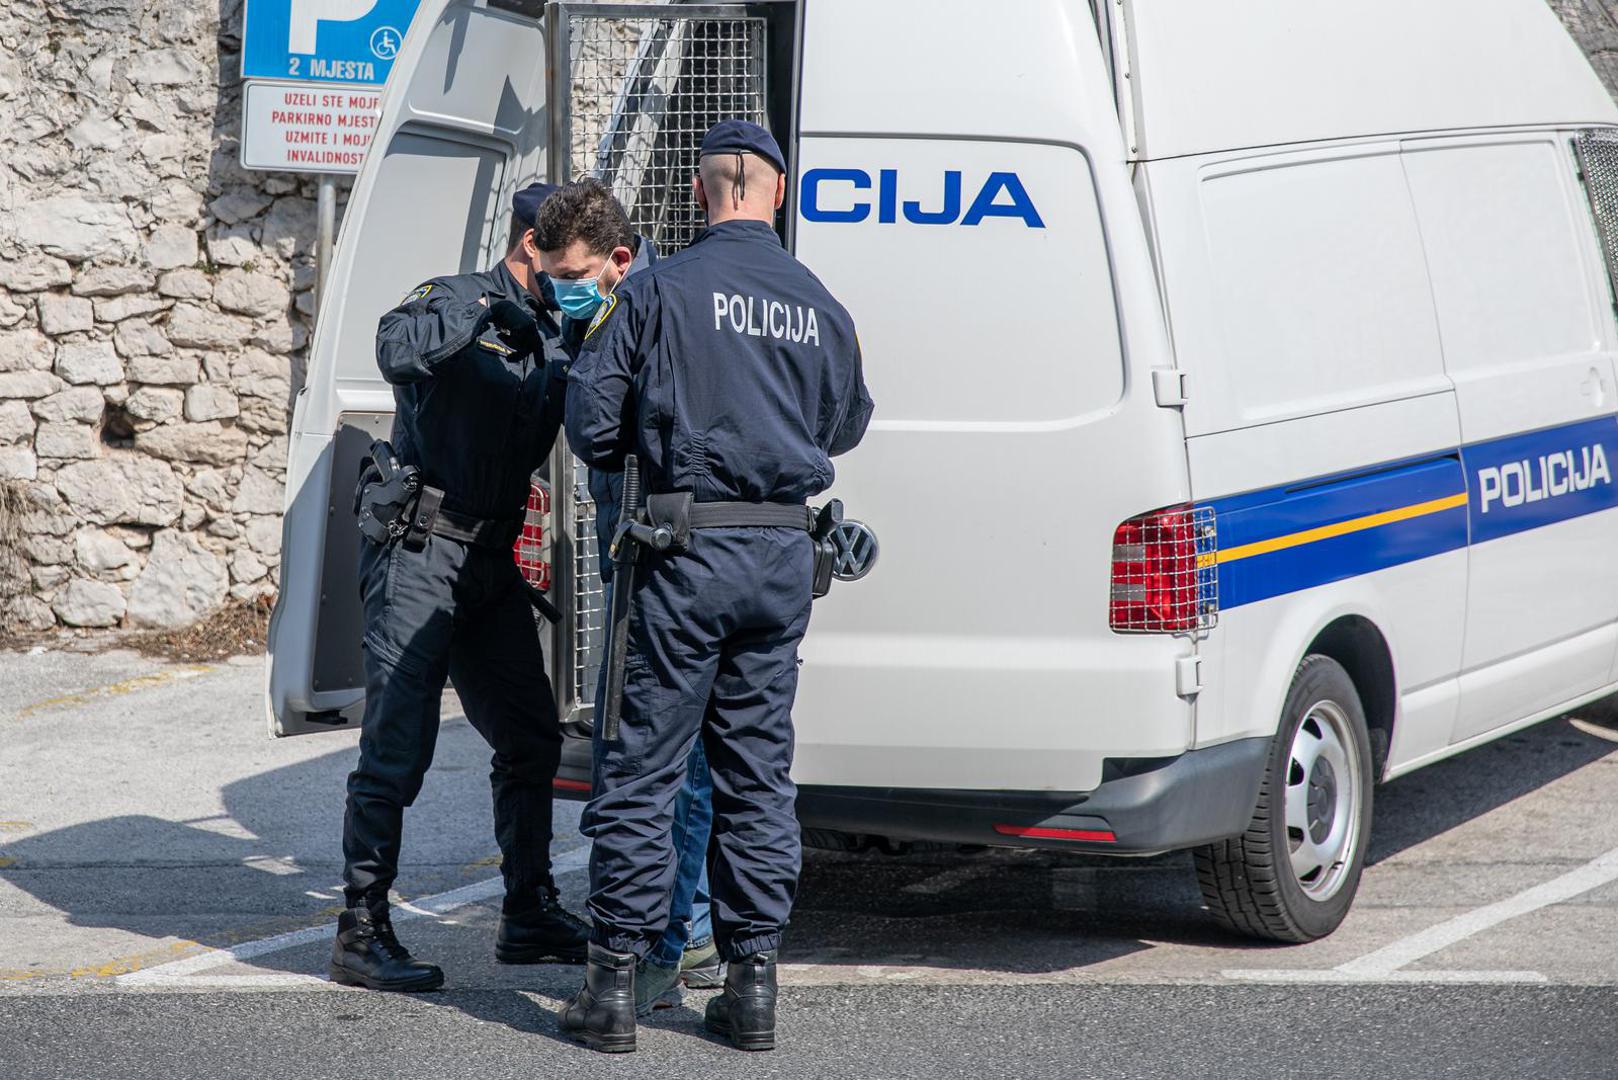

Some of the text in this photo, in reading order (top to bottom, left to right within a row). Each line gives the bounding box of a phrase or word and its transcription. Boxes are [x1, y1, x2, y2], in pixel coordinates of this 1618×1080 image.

[288, 57, 375, 81] 2 MJESTA
[284, 92, 317, 107] UZELI
[322, 94, 343, 108] STE
[272, 110, 376, 128] PARKIRNO MJEST
[285, 131, 371, 147] UZMITE I MOJ
[287, 149, 365, 165] INVALIDNOST
[800, 168, 1046, 229] CIJA
[712, 292, 820, 347] POLICIJA
[1478, 443, 1612, 514] POLICIJA
